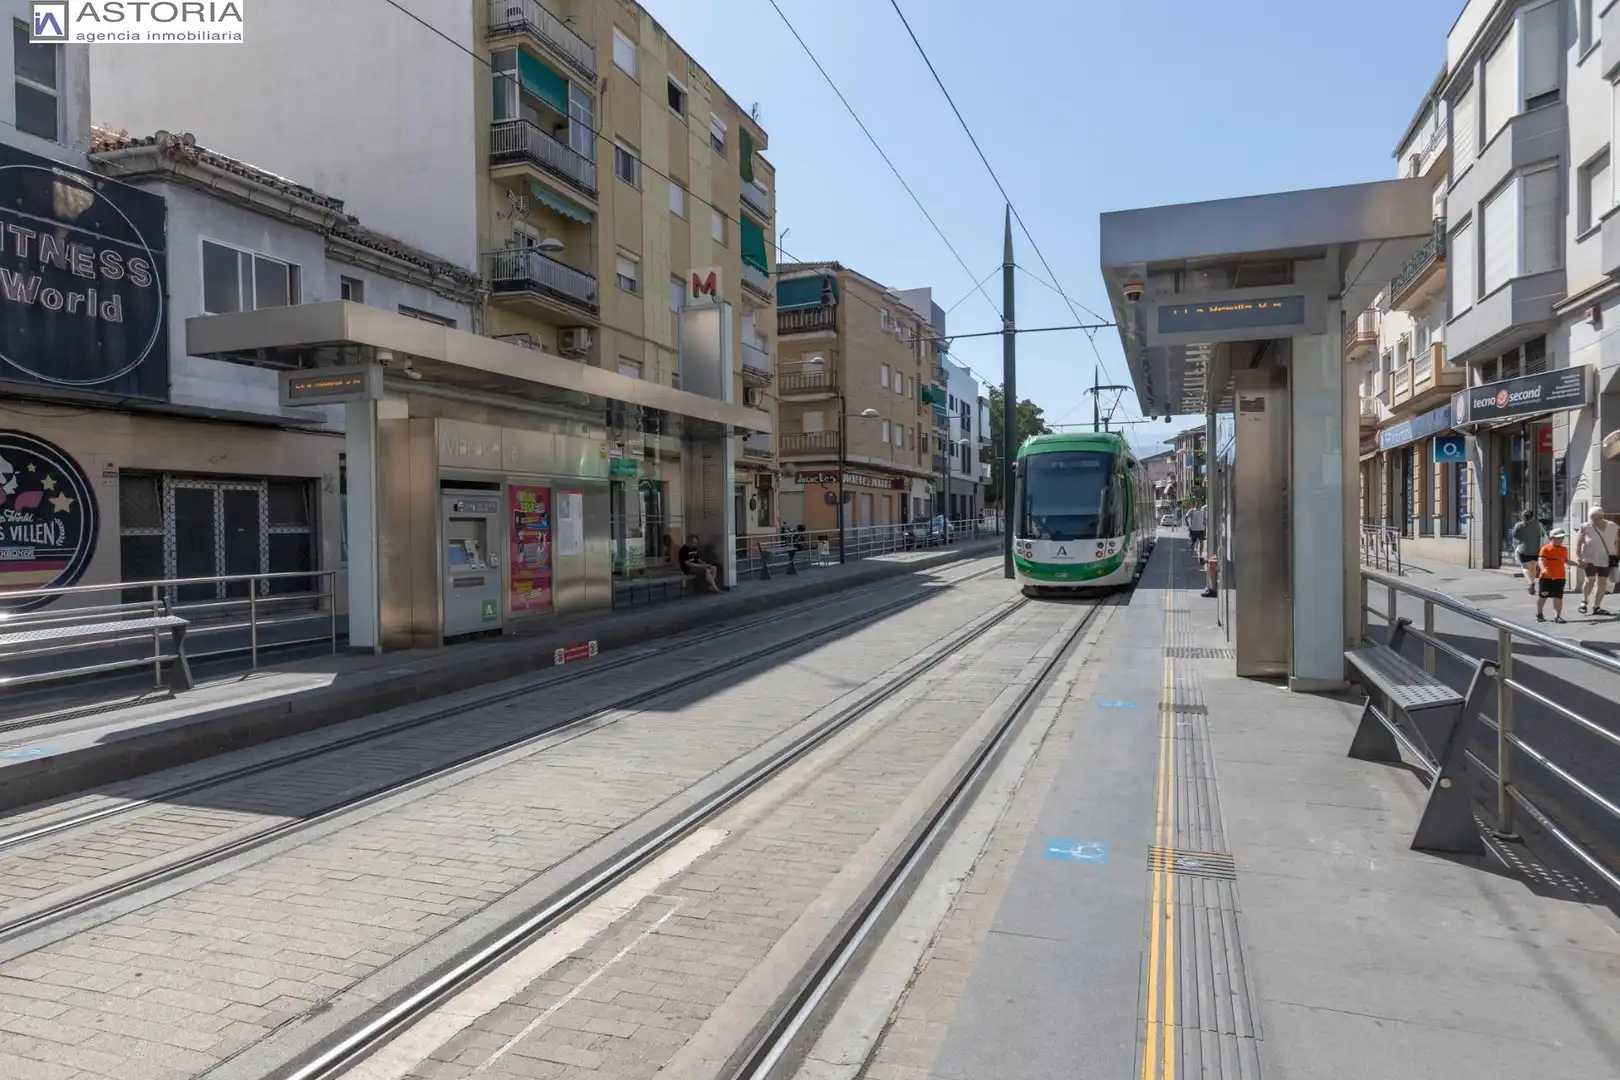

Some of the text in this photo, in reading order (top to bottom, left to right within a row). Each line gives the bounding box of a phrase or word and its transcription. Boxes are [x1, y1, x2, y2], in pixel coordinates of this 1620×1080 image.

[0, 268, 123, 323] World
[692, 271, 717, 298] M
[1473, 396, 1496, 409] tecno
[1508, 385, 1541, 402] second
[10, 521, 55, 546] VILLEN
